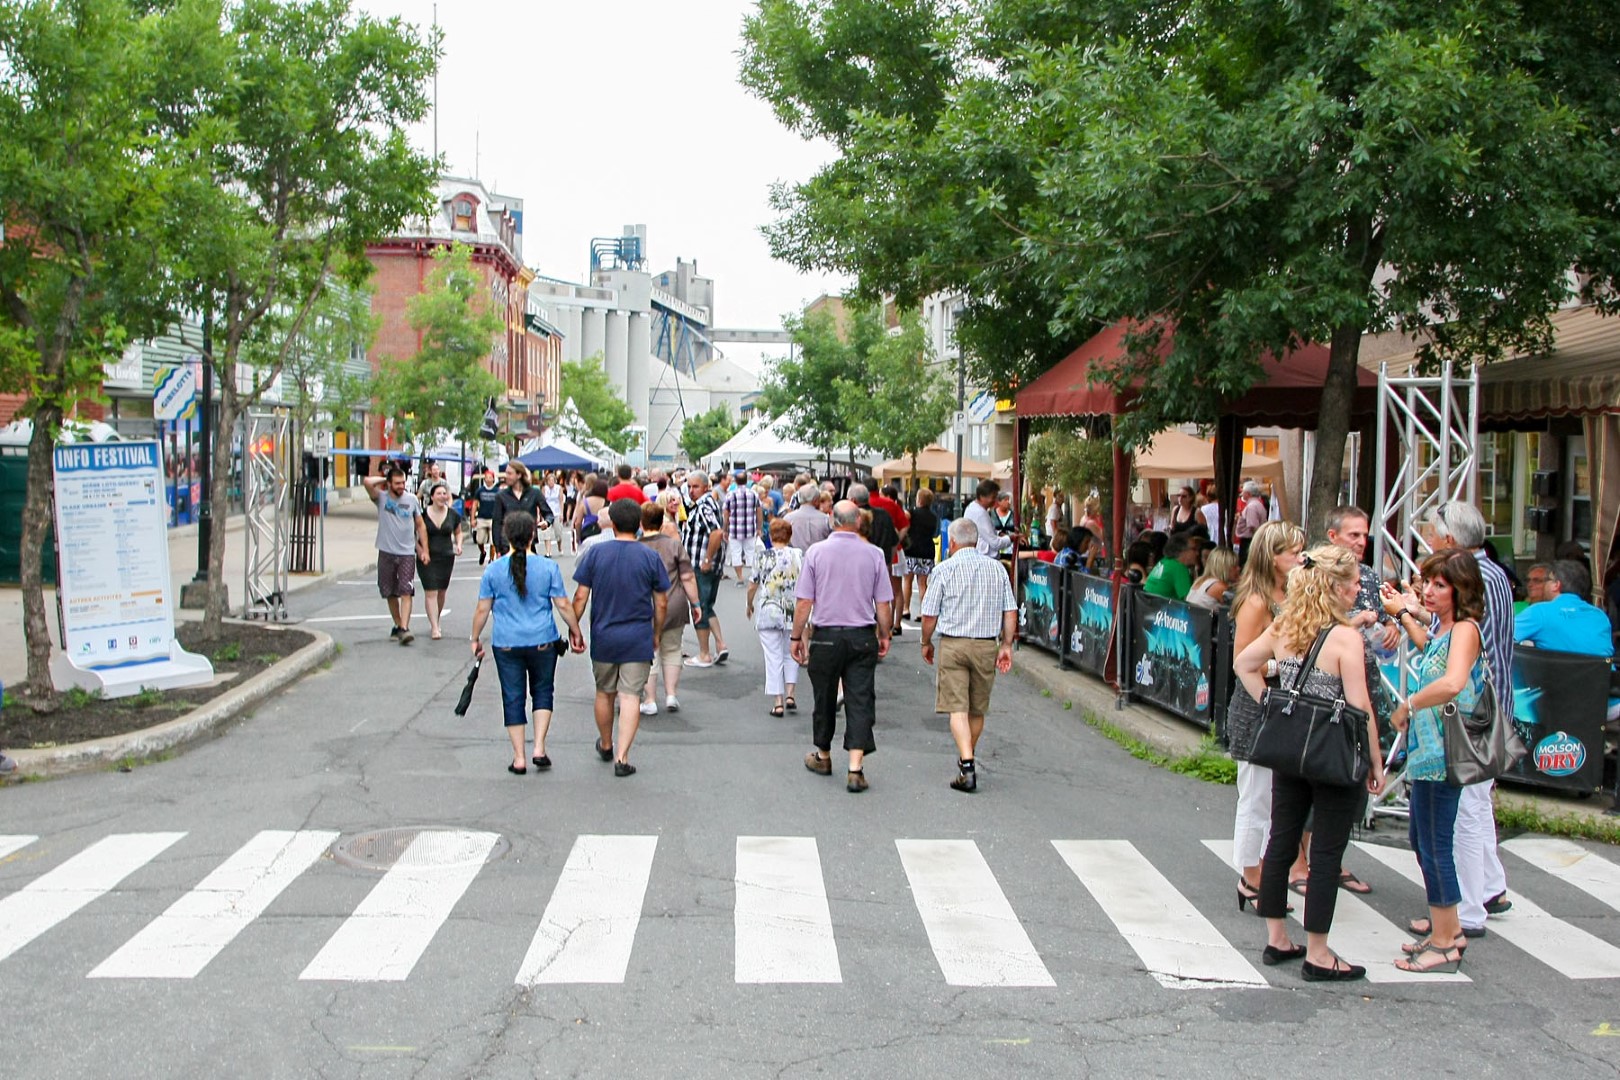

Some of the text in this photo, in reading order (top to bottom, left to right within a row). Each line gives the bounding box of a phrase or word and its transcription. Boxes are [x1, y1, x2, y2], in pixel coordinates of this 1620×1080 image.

[161, 370, 192, 408] GIBELOTTE
[957, 413, 964, 422] P
[317, 431, 325, 442] P
[57, 446, 153, 468] INFO FESTIVAL
[1538, 742, 1581, 754] MOLSON
[1537, 752, 1581, 770] DRY
